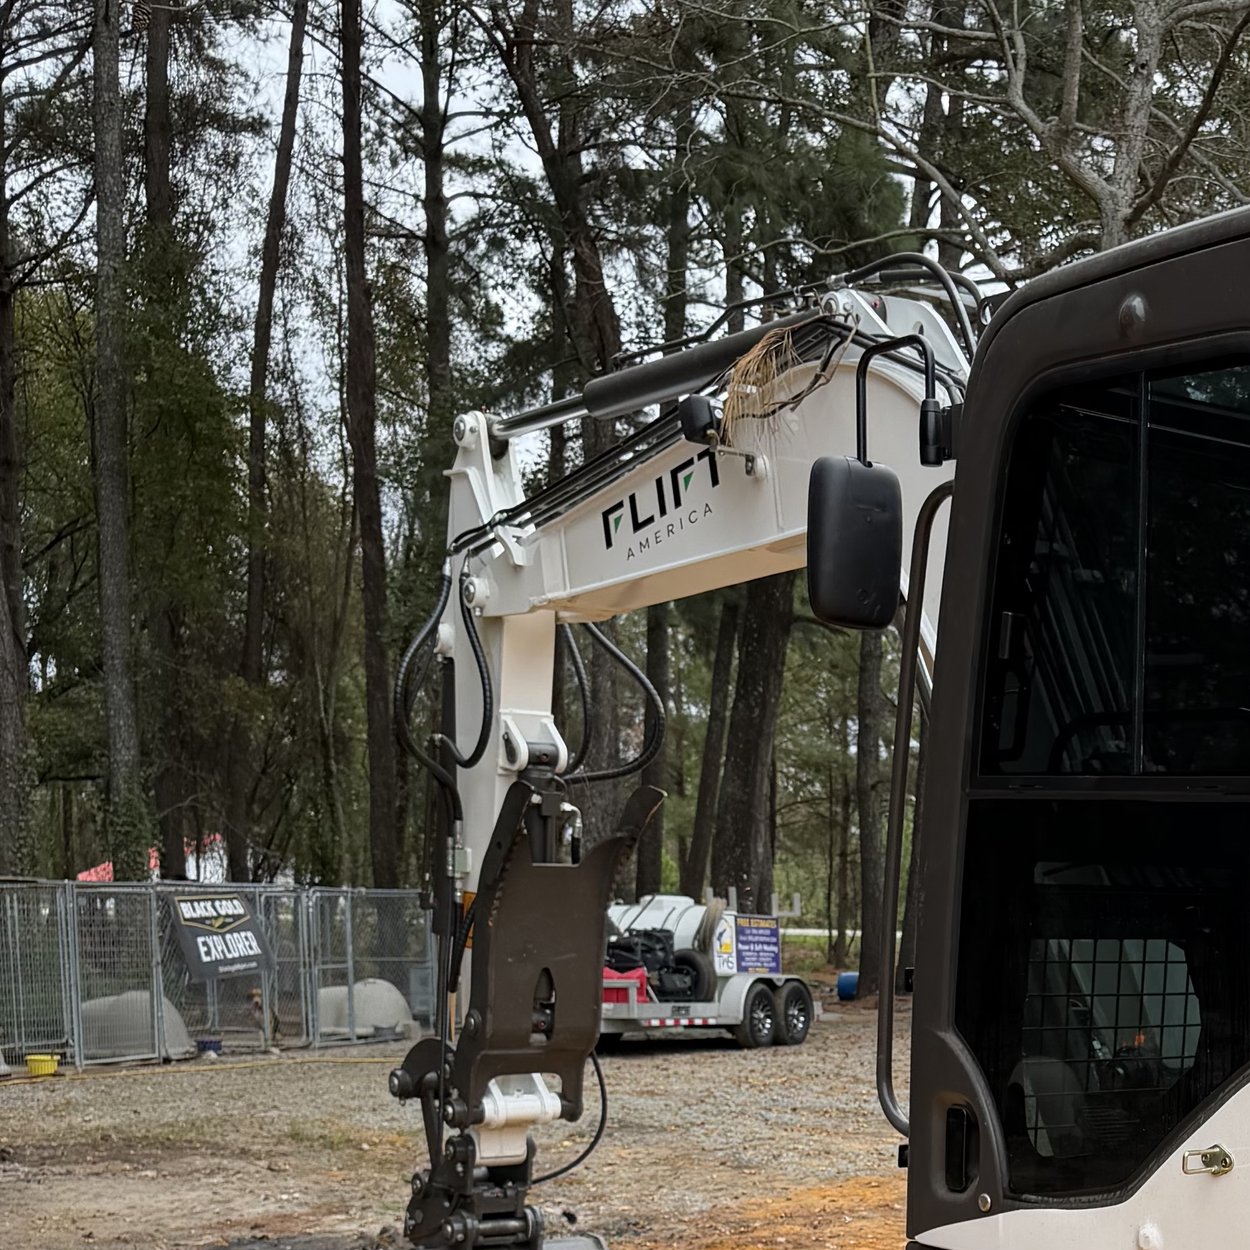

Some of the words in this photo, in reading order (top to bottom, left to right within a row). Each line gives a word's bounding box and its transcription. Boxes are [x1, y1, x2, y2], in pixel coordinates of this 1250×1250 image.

[602, 447, 719, 550] FLIFT
[626, 502, 713, 560] AMERICA
[180, 901, 218, 918] BLACK
[214, 900, 245, 916] GOLD
[196, 931, 262, 962] EXPLORER
